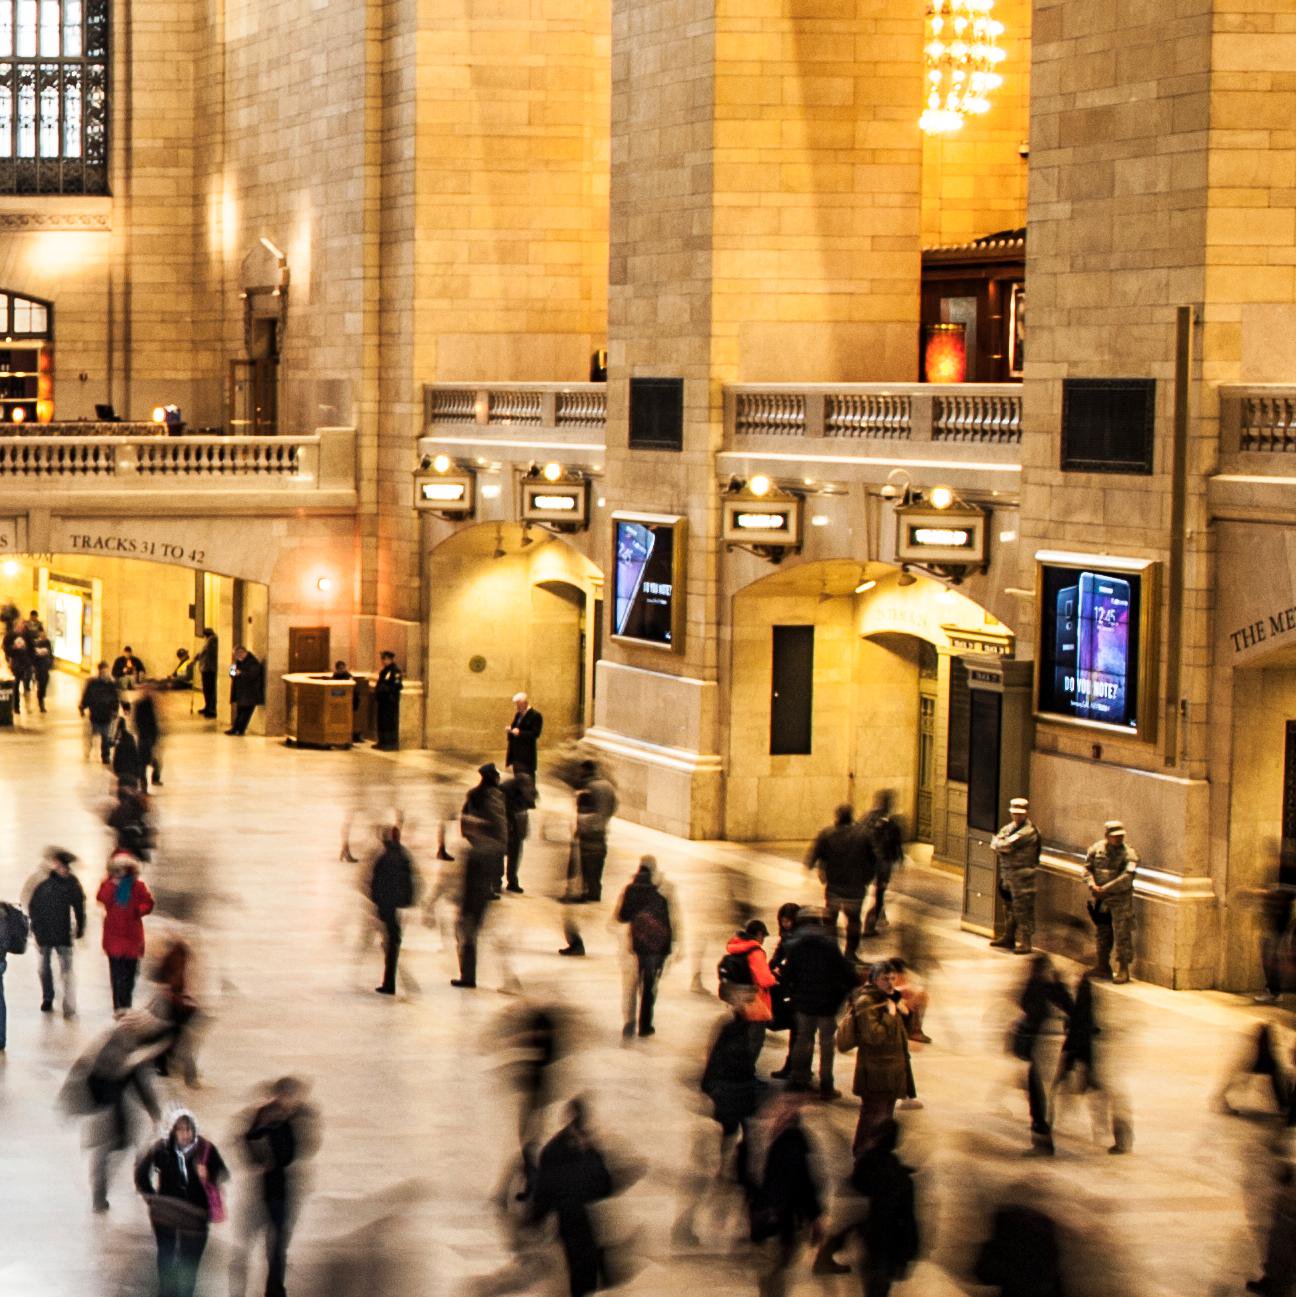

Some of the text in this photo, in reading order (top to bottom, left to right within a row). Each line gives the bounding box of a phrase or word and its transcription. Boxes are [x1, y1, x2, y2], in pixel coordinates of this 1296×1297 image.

[70, 534, 205, 563] TRACKS 31 TO 42
[1230, 606, 1296, 652] THE ME
[1077, 678, 1091, 696] YOU
